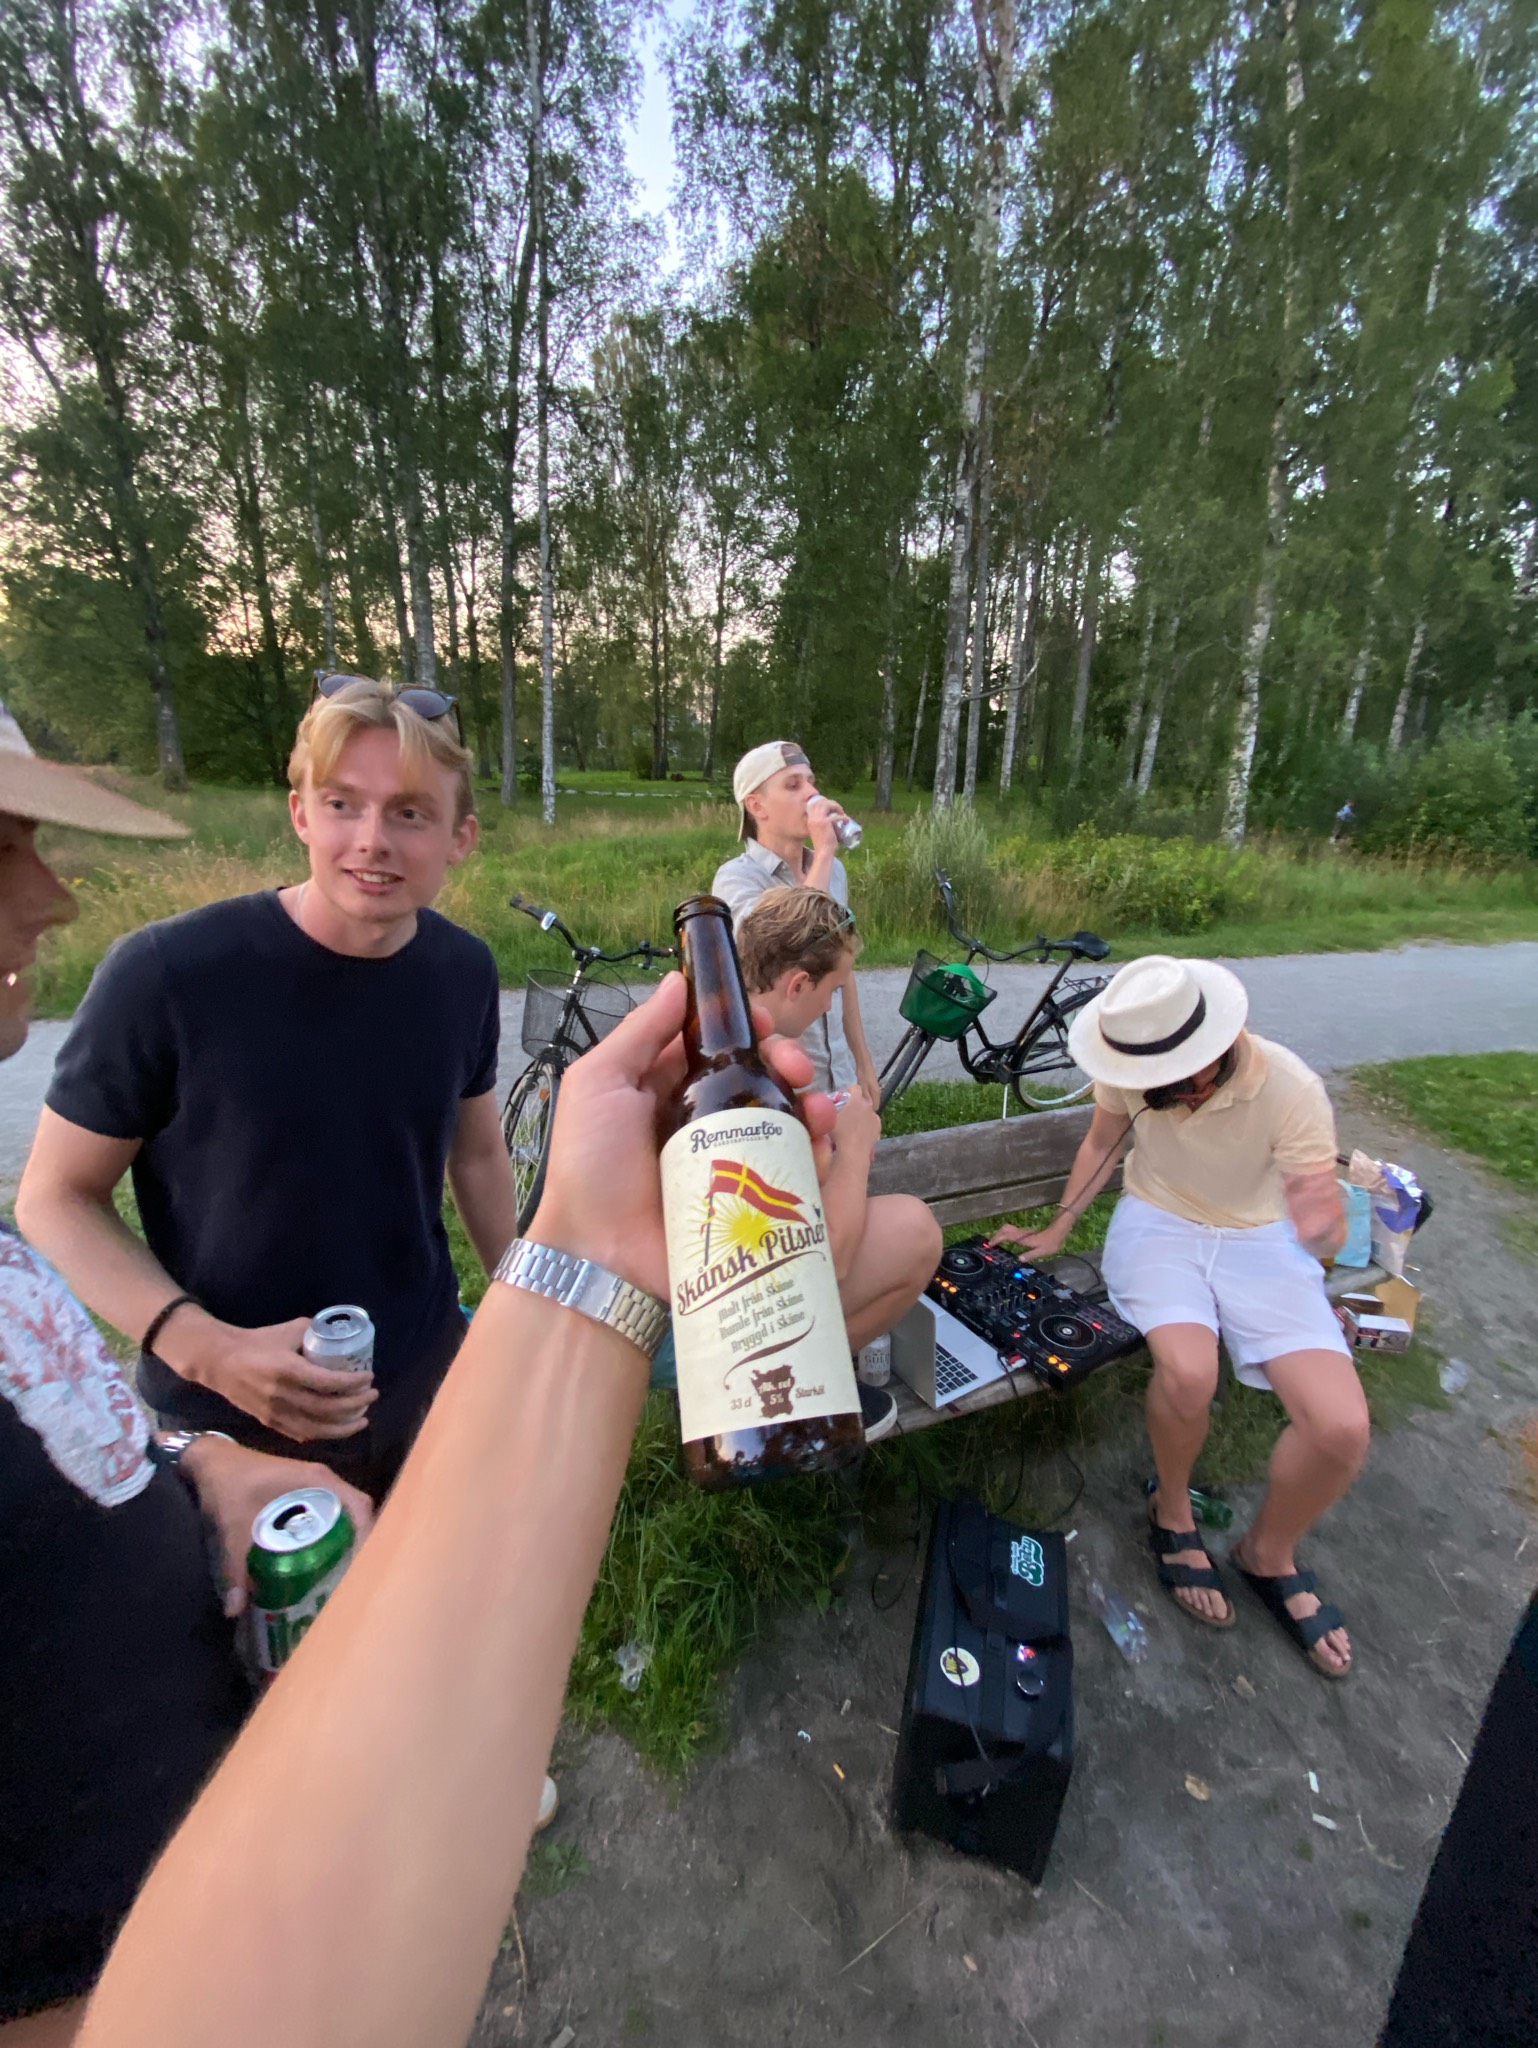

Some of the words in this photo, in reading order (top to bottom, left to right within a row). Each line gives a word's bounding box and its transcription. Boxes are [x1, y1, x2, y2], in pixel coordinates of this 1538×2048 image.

[691, 1121, 782, 1153] Remmarlöv
[676, 1245, 758, 1316] Skånsk
[758, 1223, 825, 1261] Pilsner
[730, 1322, 769, 1354] Bryggd
[730, 1397, 743, 1411] 33
[769, 1393, 785, 1405] 5%
